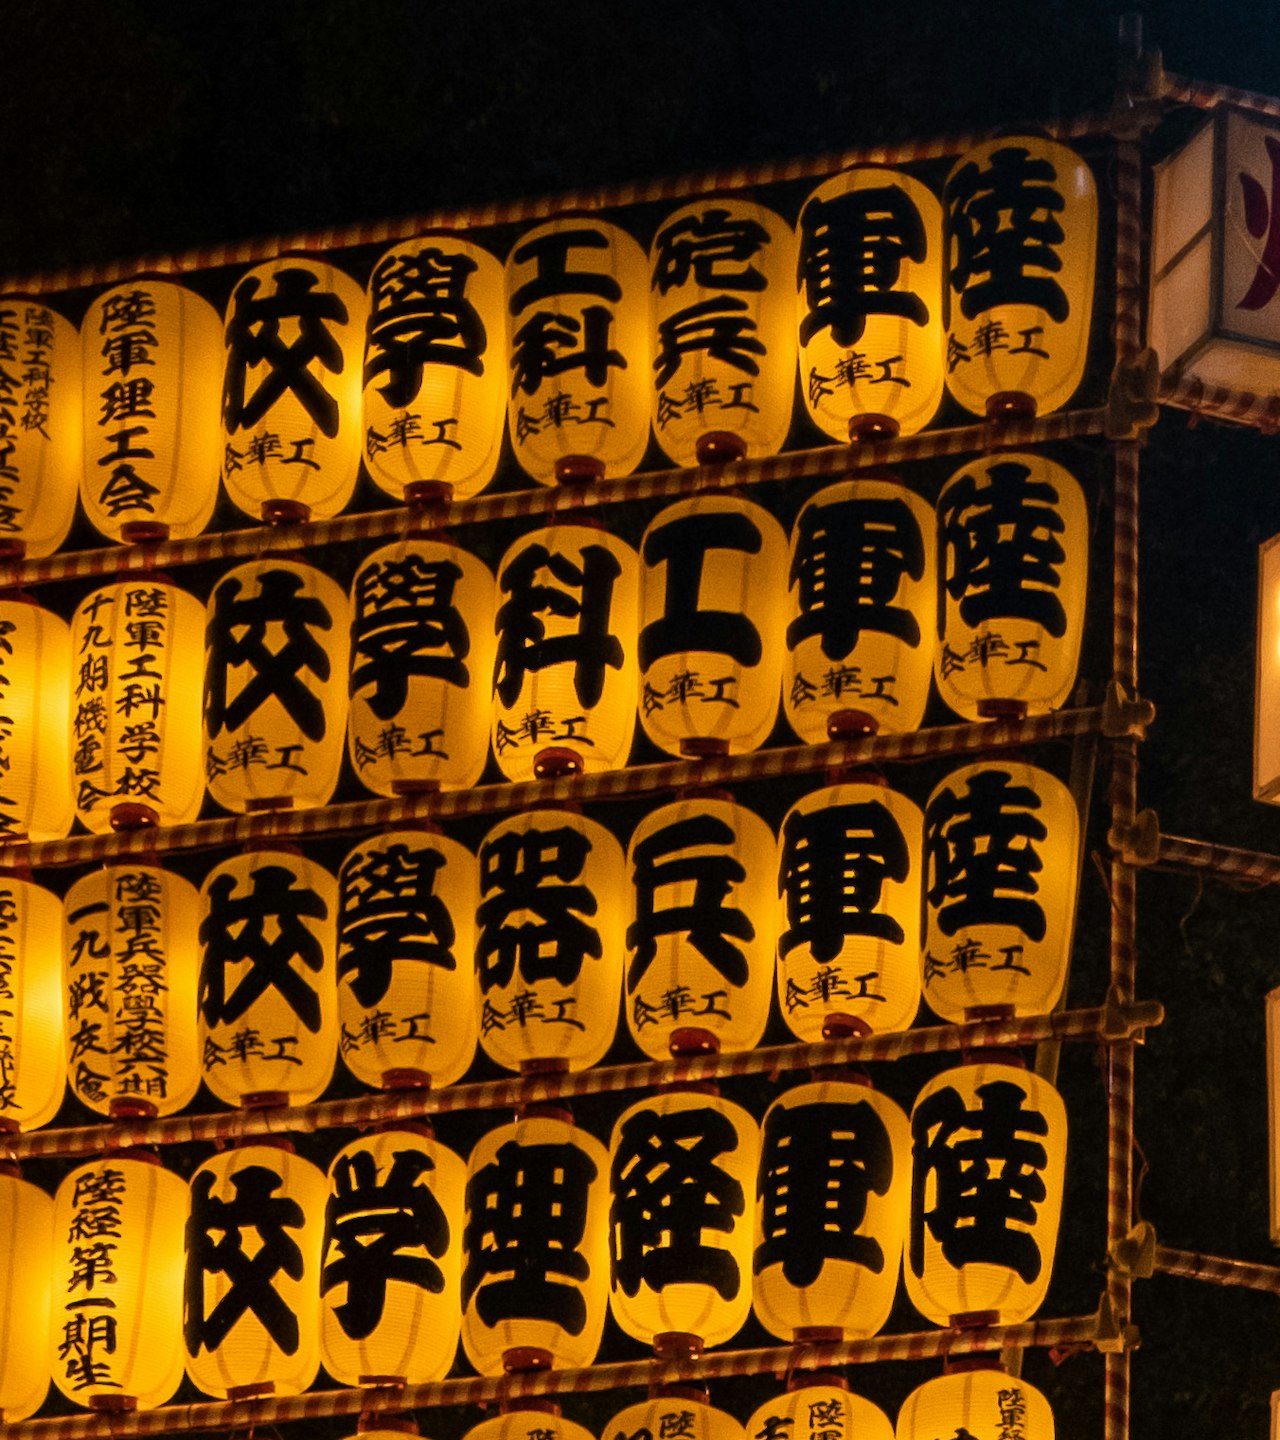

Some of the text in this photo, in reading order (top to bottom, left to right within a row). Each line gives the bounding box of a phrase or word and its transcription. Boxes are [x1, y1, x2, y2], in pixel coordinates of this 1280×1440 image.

[798, 184, 928, 347] 軍
[945, 147, 1071, 324] 陸
[223, 268, 349, 438] 校
[494, 544, 625, 709] 科
[638, 512, 763, 667] 工
[786, 498, 924, 660] 軍
[938, 462, 1069, 638] 陸
[204, 569, 332, 742] 校
[475, 828, 603, 987] 器
[625, 816, 754, 987] 兵
[777, 801, 910, 963] 軍
[923, 770, 1048, 941] 陸
[198, 866, 326, 1033] 校
[184, 1166, 305, 1357] 校
[753, 1100, 894, 1288] 軍
[909, 1081, 1048, 1283] 陸
